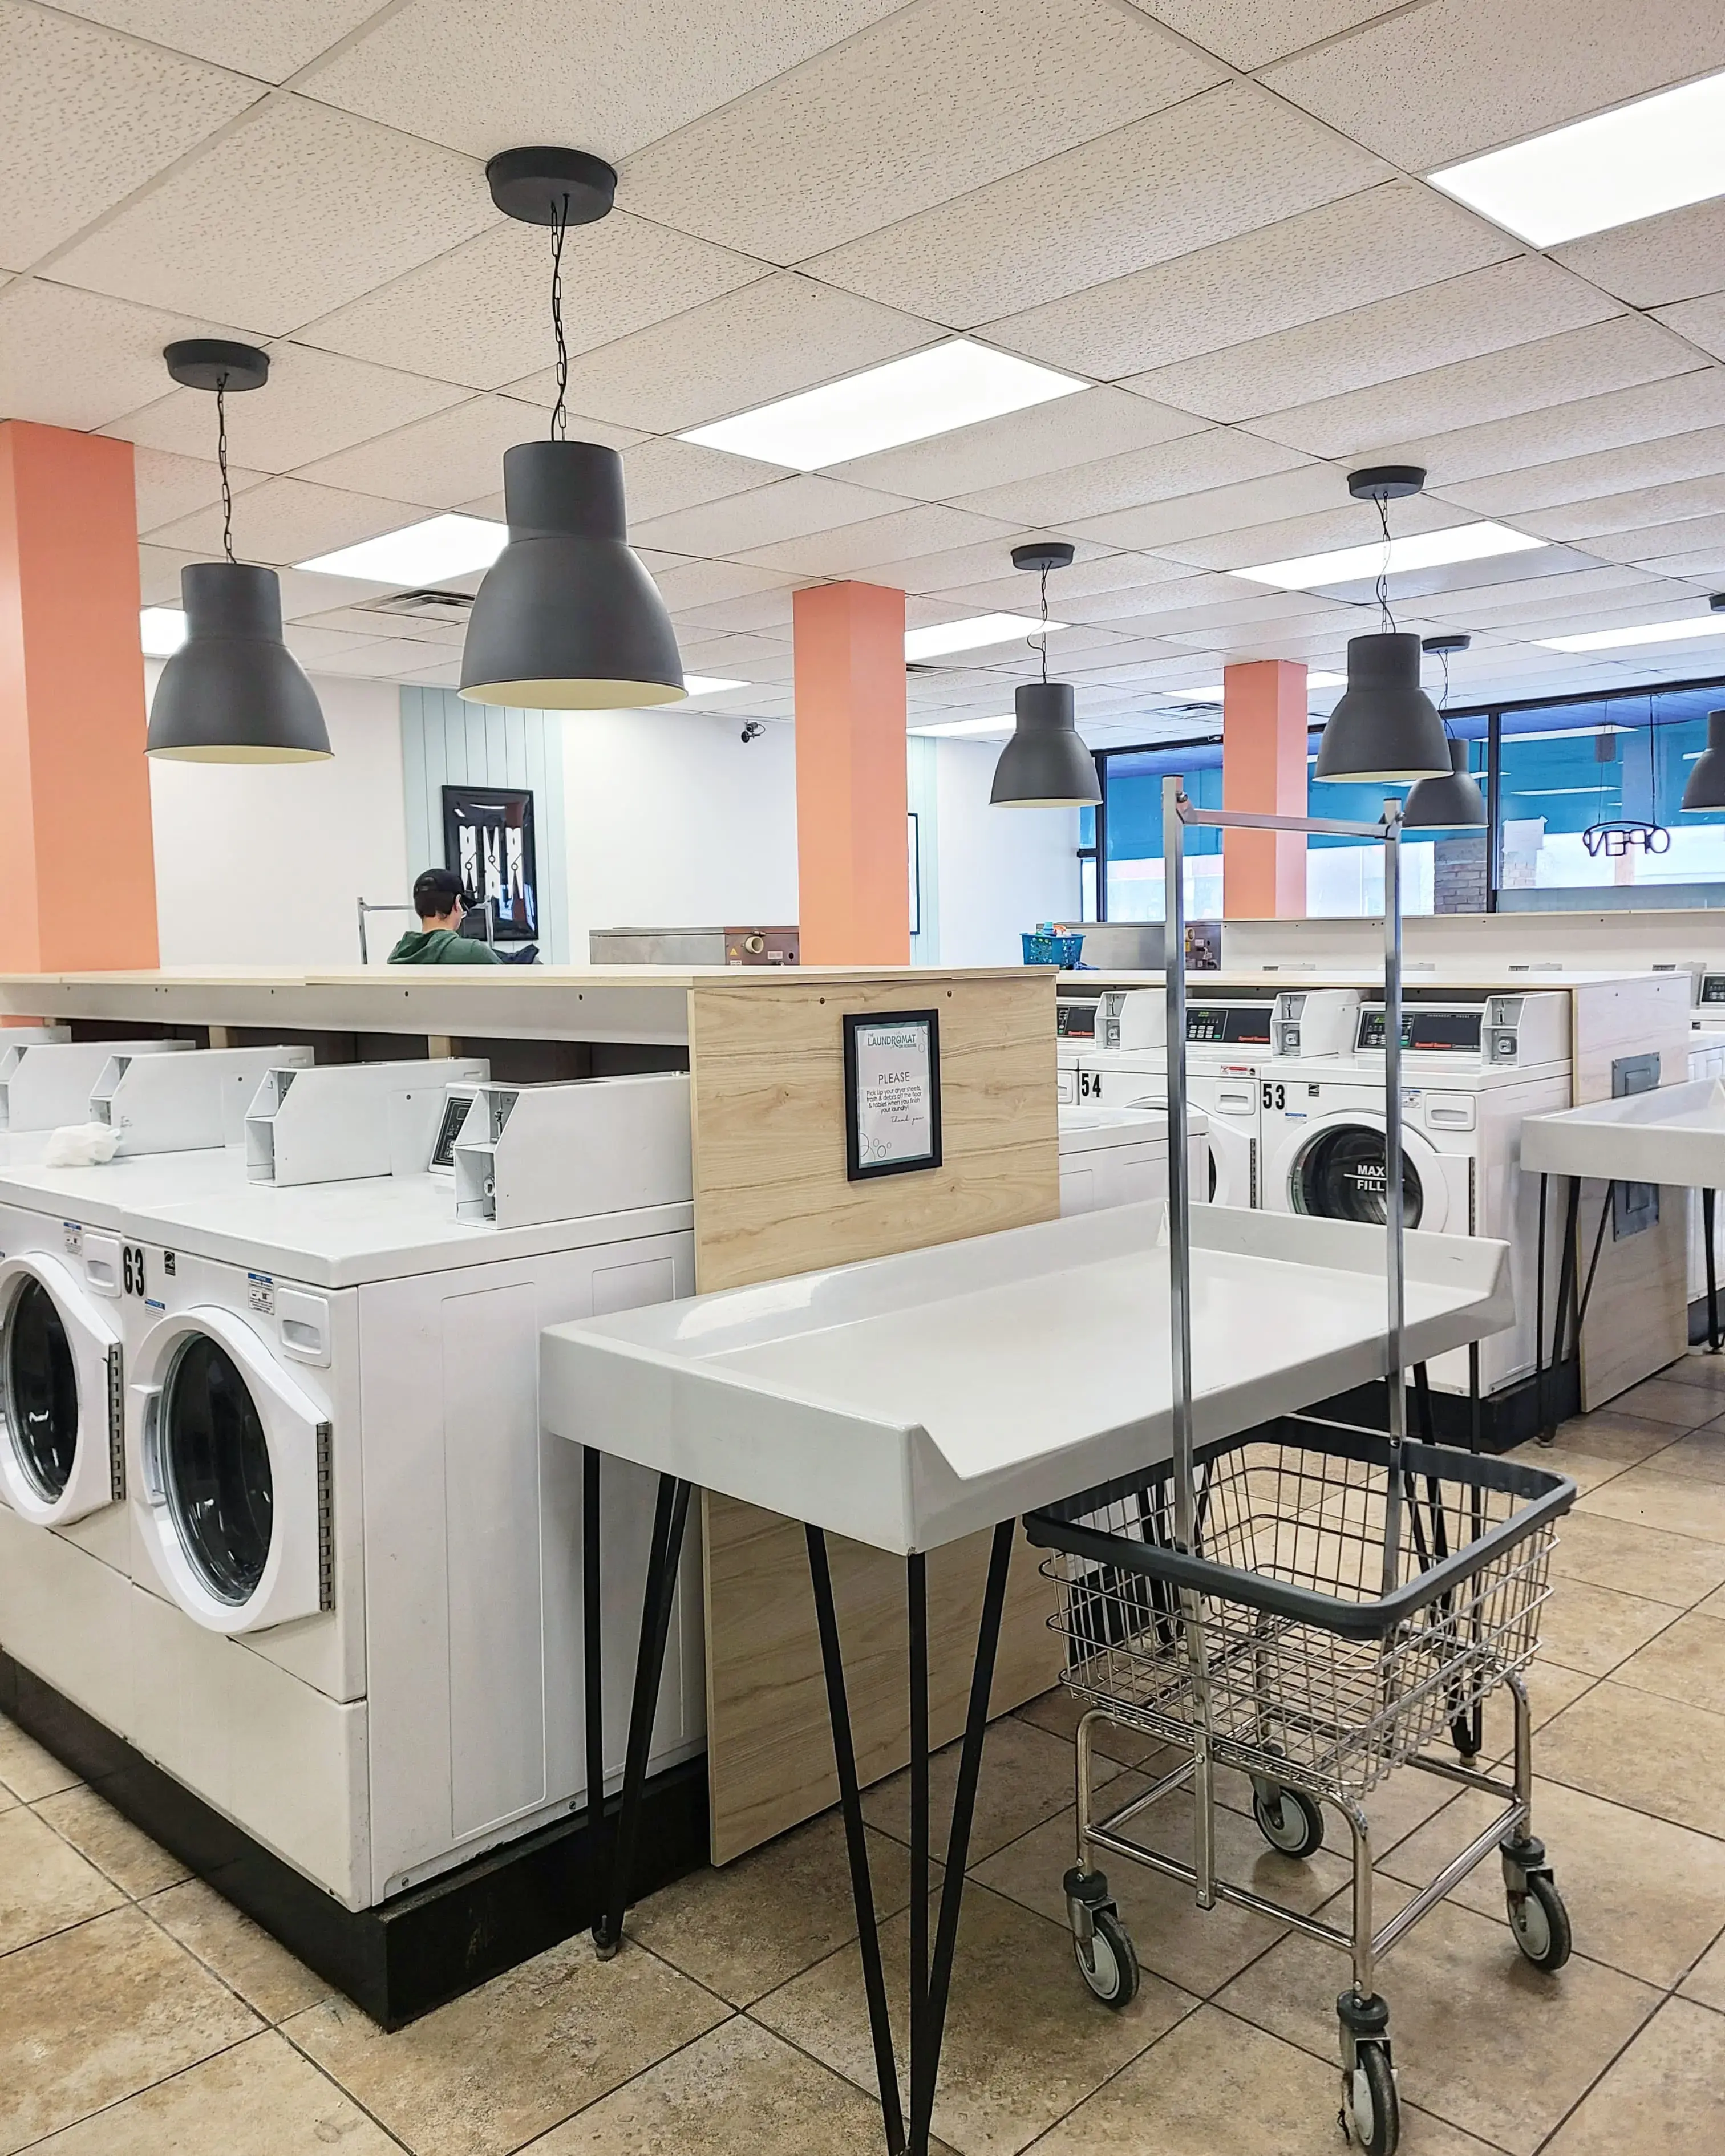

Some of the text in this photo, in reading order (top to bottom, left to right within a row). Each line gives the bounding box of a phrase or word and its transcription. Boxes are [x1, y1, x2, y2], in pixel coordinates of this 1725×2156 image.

[868, 1034, 916, 1047] LAUNDROMAT
[878, 1071, 910, 1085] PLEASE
[1081, 1073, 1102, 1098] 54
[1262, 1083, 1285, 1110] 53
[1357, 1164, 1385, 1177] MAX
[1356, 1180, 1385, 1192] FILL
[123, 1246, 145, 1297] 63
